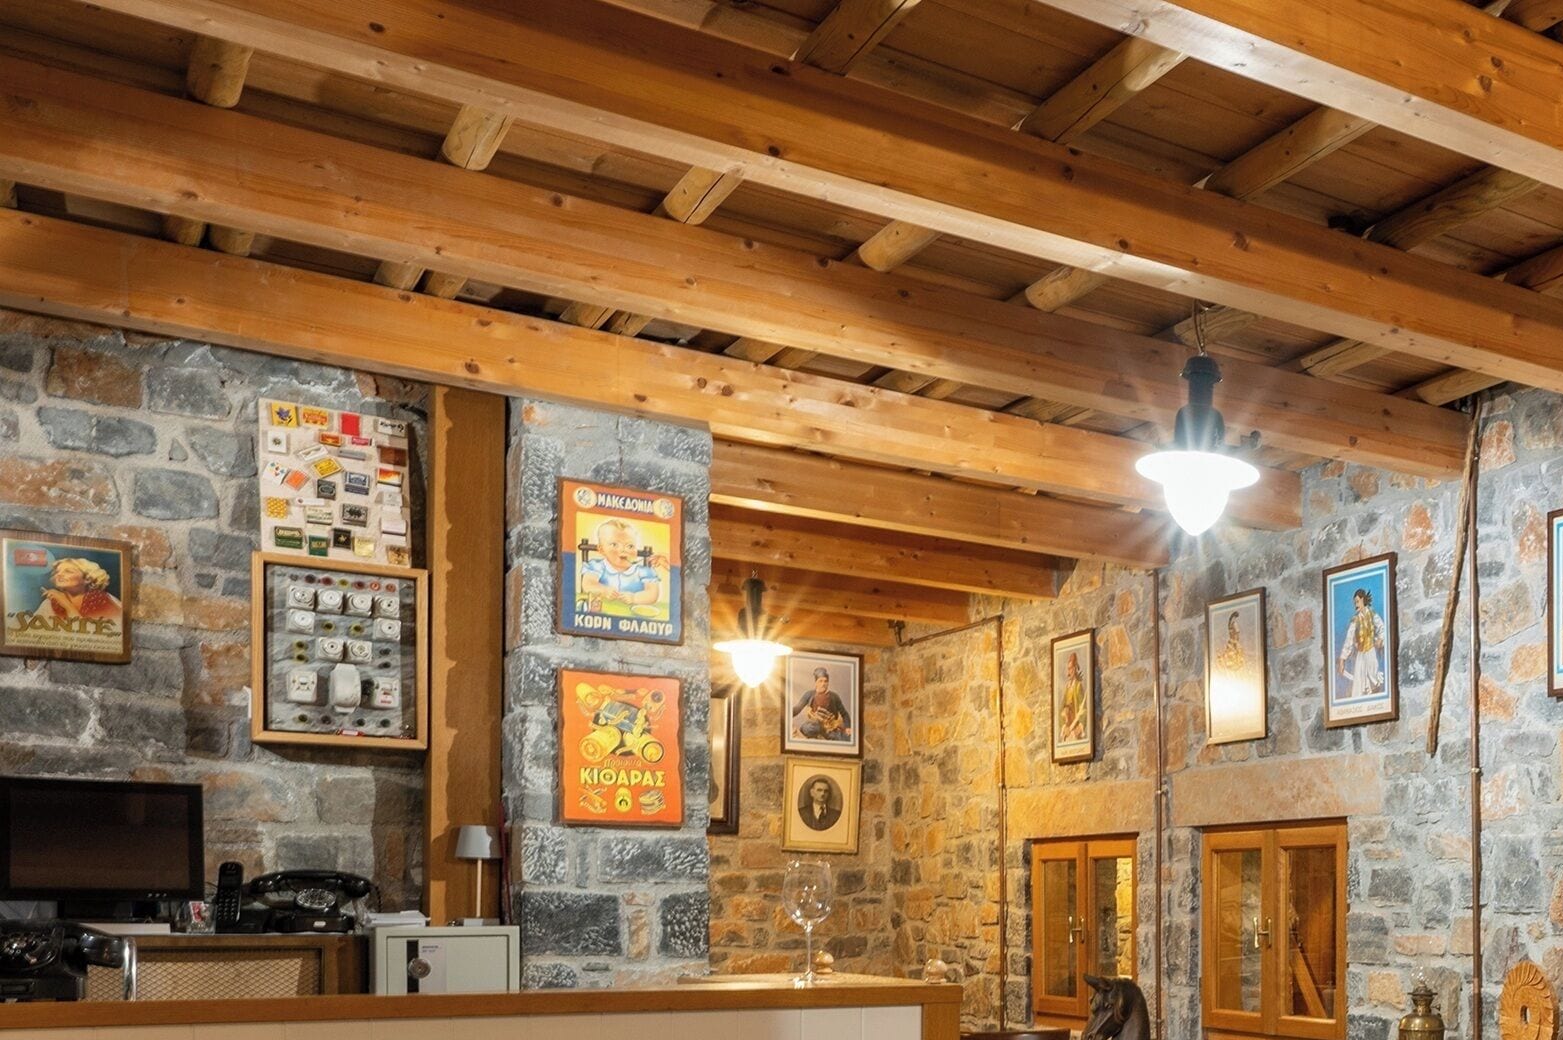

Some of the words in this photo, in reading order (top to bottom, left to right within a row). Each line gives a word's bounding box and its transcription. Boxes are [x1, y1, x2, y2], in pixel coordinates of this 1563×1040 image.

[574, 614, 612, 631] ΚΟΡΝ
[618, 618, 673, 636] ΦΛΑΟΥΡ
[580, 767, 665, 787] ΚΙΘΑΡΑΣ
